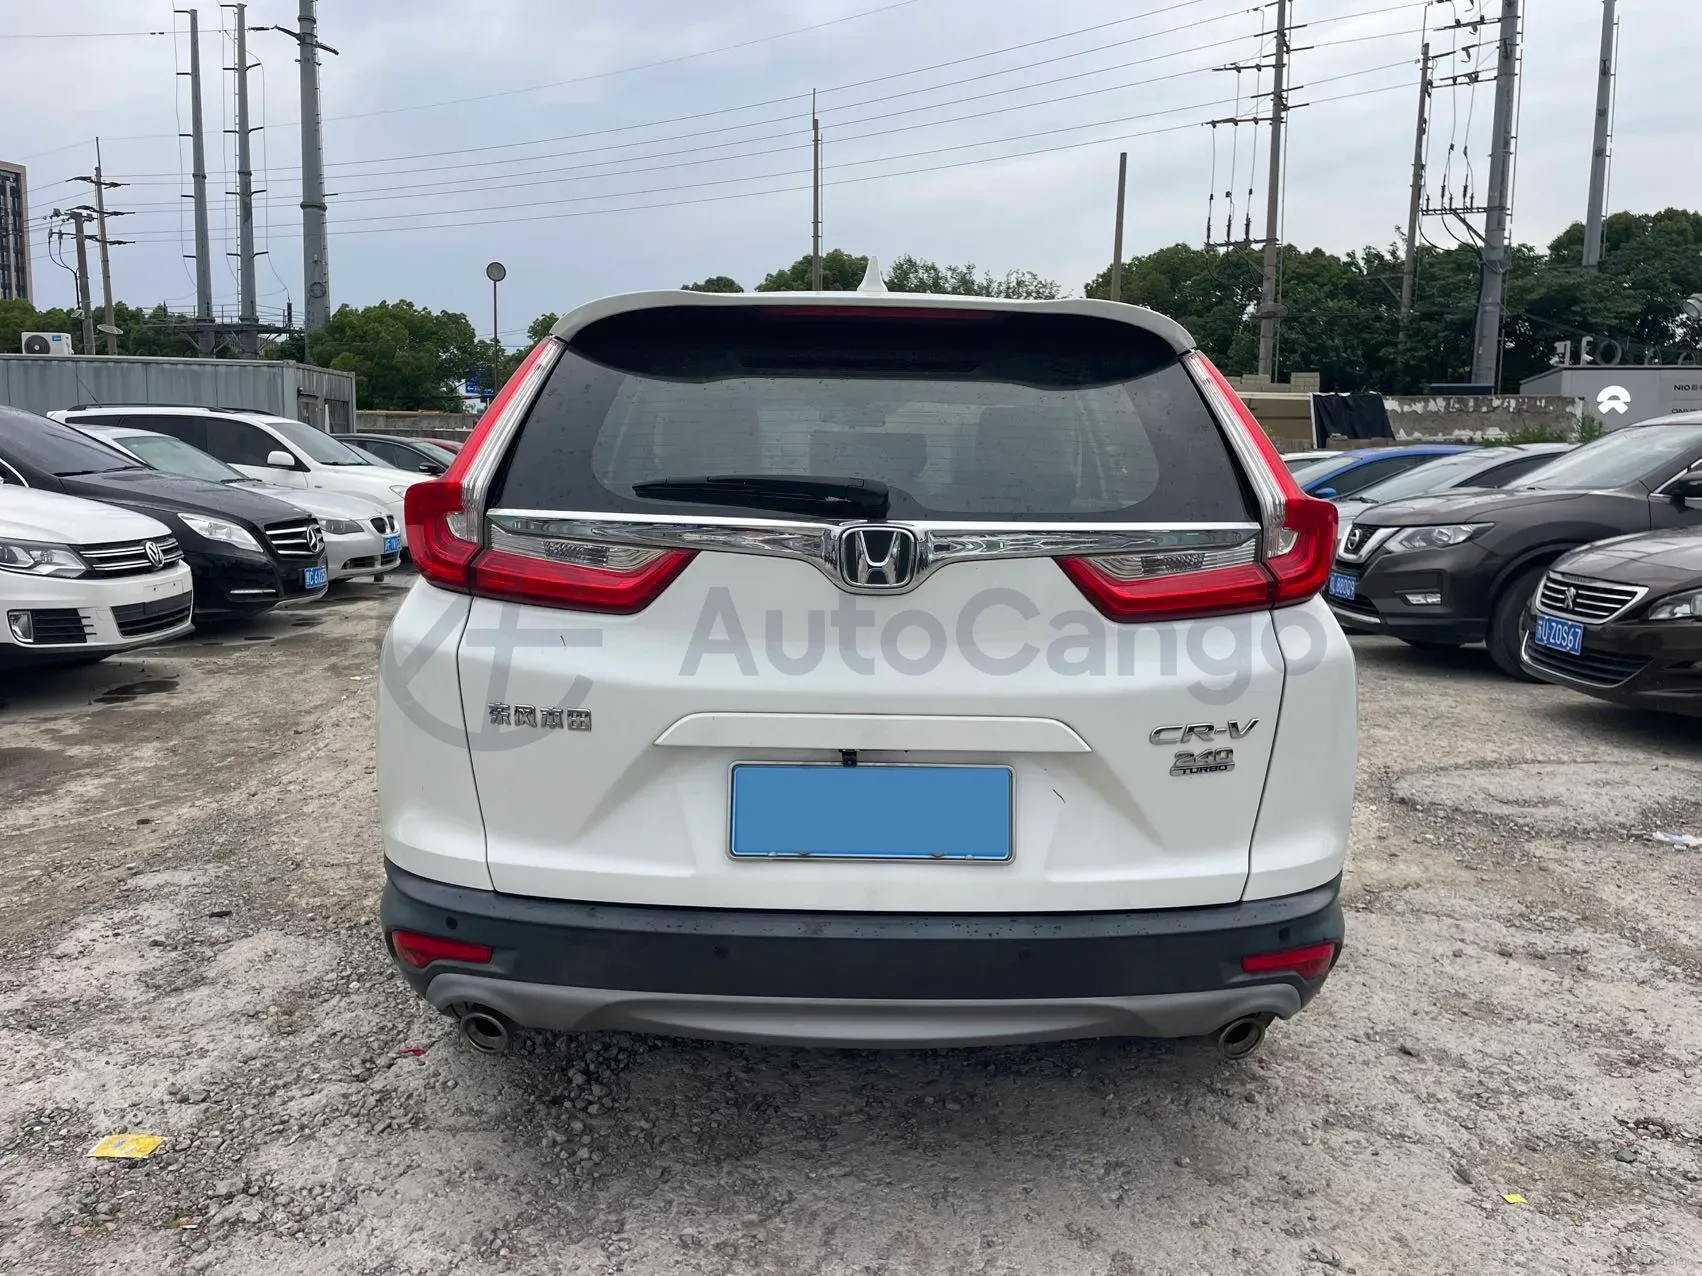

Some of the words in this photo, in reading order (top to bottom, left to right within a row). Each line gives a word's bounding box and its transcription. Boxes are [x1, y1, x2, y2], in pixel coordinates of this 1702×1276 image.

[488, 702, 592, 732] 东风本田
[1149, 717, 1260, 745] CR-V
[1174, 747, 1234, 767] 240
[1182, 764, 1229, 775] TURBO
